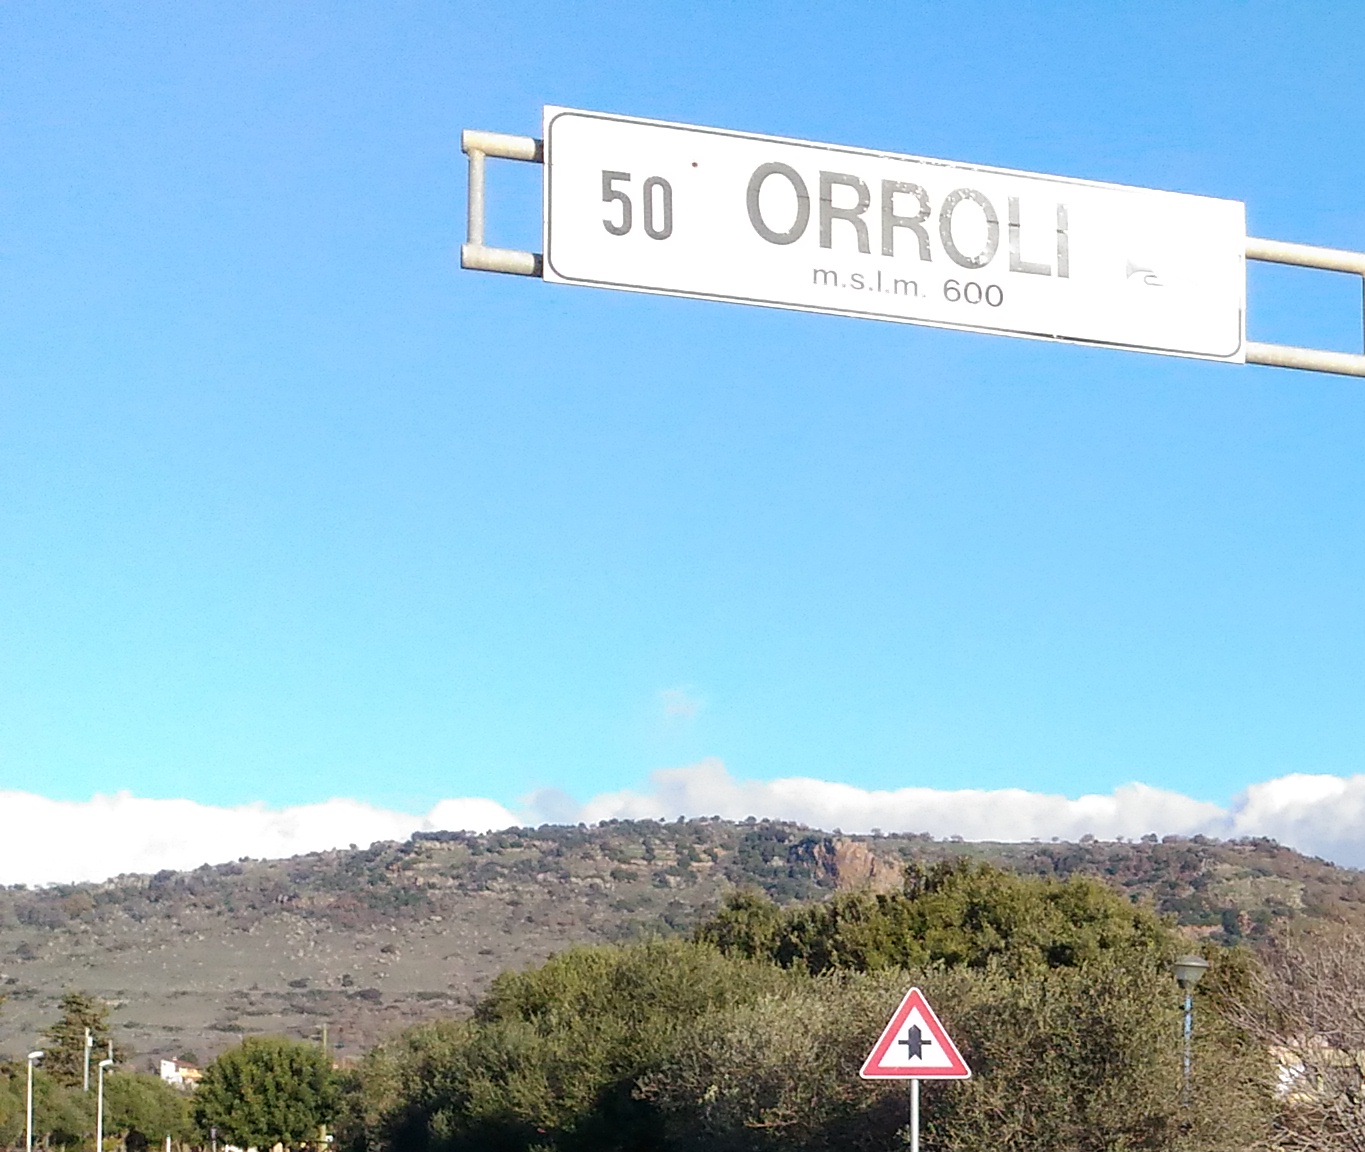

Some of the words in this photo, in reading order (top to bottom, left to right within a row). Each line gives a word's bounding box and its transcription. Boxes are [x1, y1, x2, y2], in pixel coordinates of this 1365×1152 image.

[602, 169, 674, 241] 50
[745, 161, 1070, 278] ORROLI
[942, 278, 1004, 308] 600
